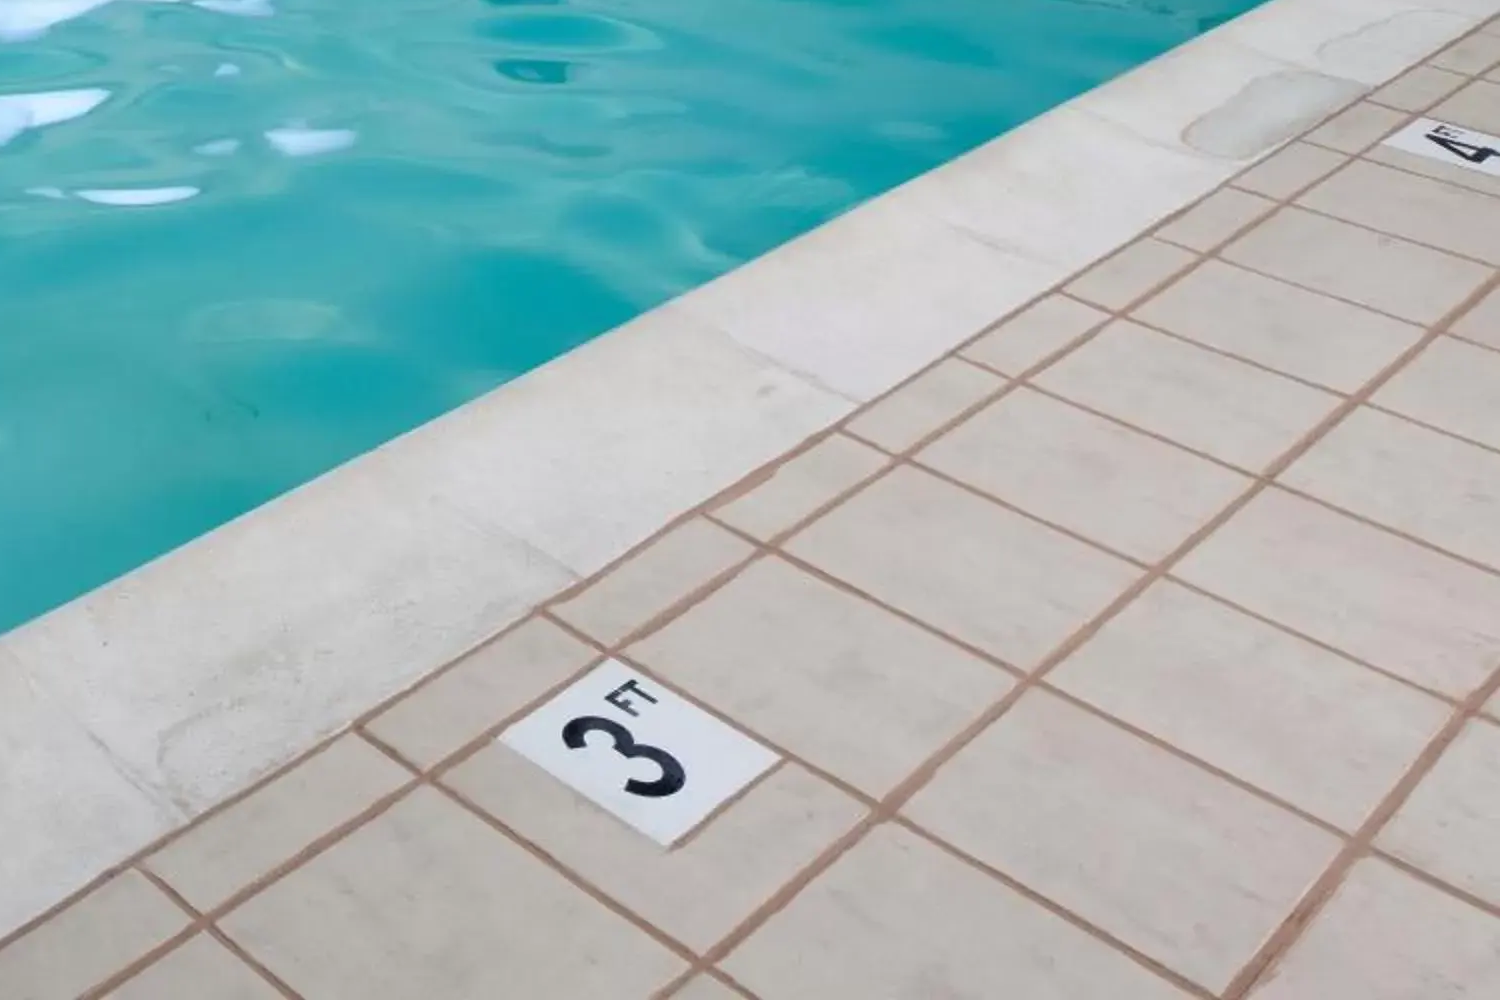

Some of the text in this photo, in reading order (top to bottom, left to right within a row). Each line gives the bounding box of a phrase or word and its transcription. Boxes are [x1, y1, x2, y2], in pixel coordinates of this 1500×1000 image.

[1424, 133, 1500, 164] 4
[562, 679, 686, 798] 3 FT
